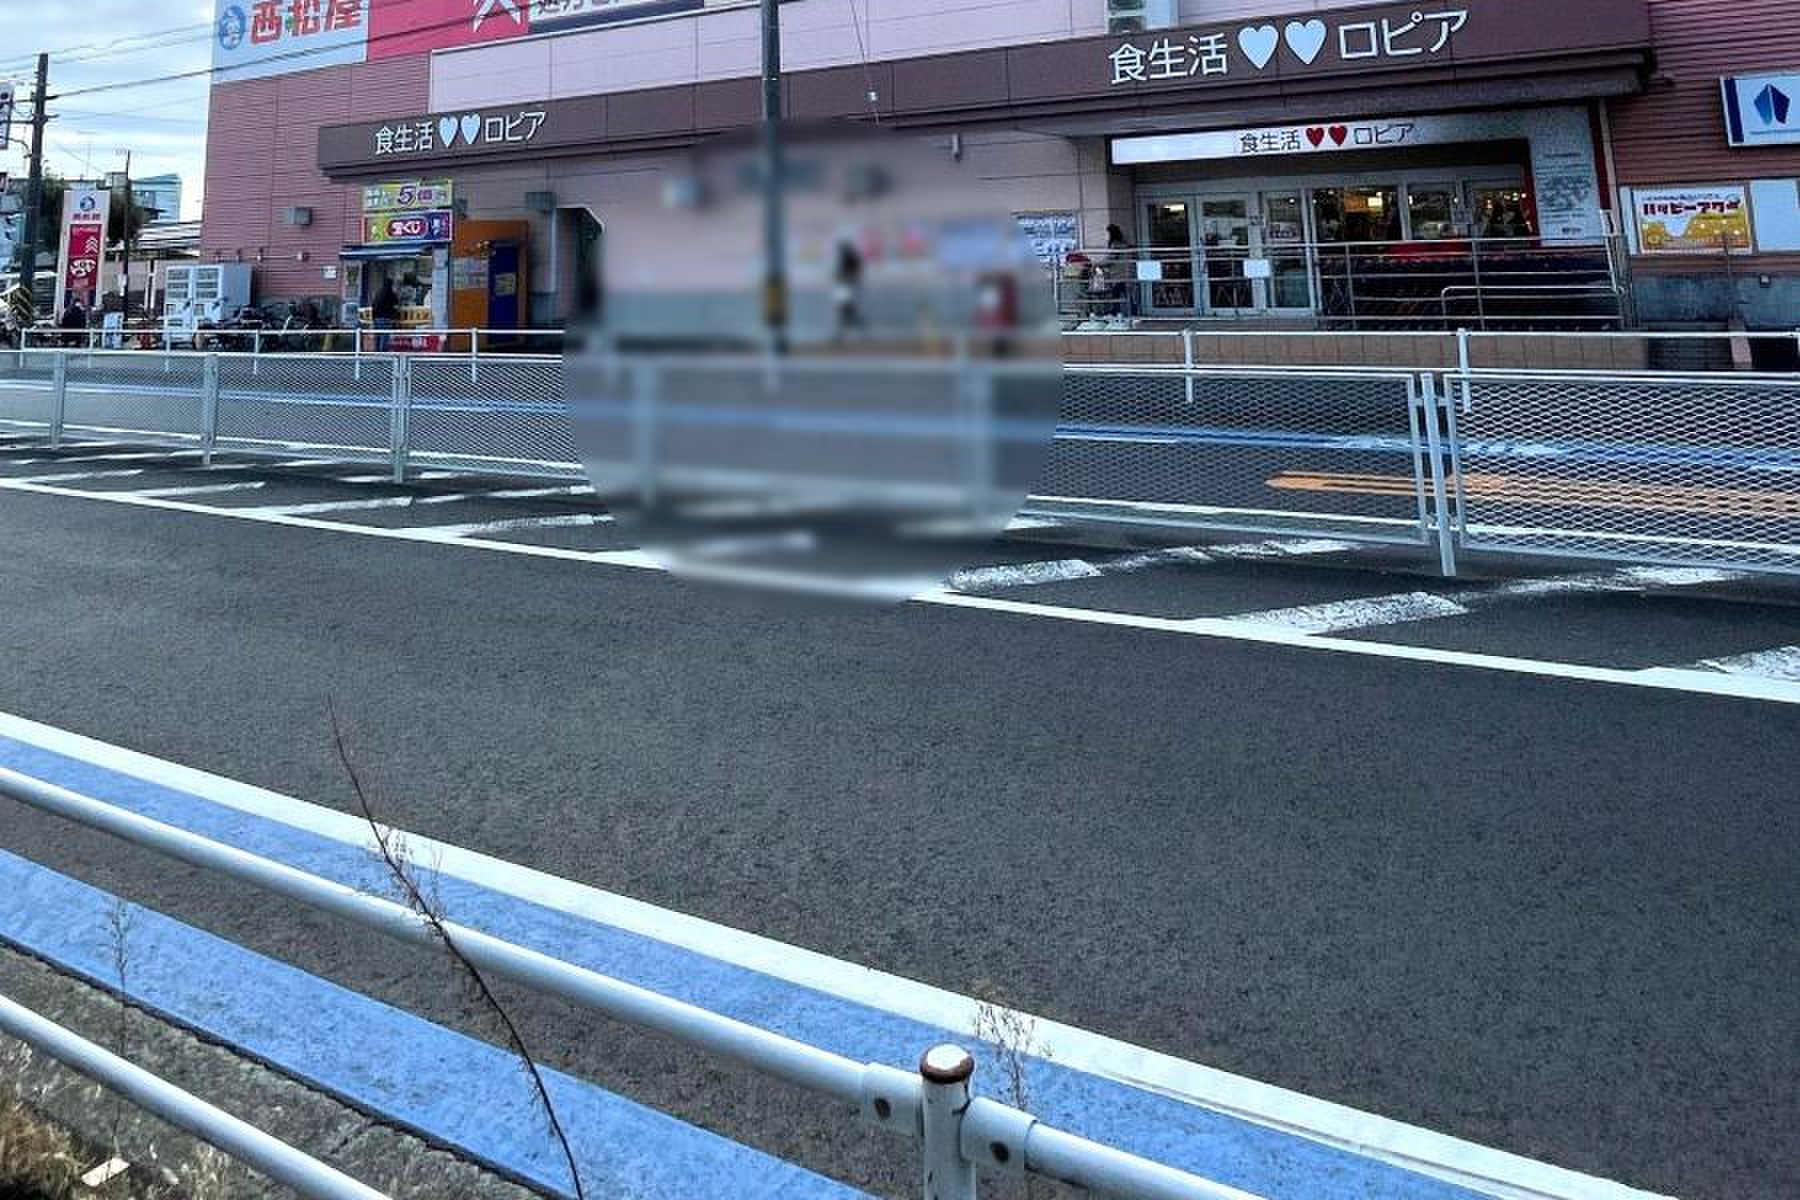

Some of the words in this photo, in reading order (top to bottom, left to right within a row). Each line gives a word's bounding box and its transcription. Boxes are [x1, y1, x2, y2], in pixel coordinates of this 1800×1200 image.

[1108, 32, 1228, 85] 食生活
[1338, 9, 1468, 60] ロピア
[375, 120, 433, 155] 食生活
[485, 111, 547, 142] ロピア
[1239, 130, 1301, 153] 食生活
[1353, 122, 1415, 146] ロピア
